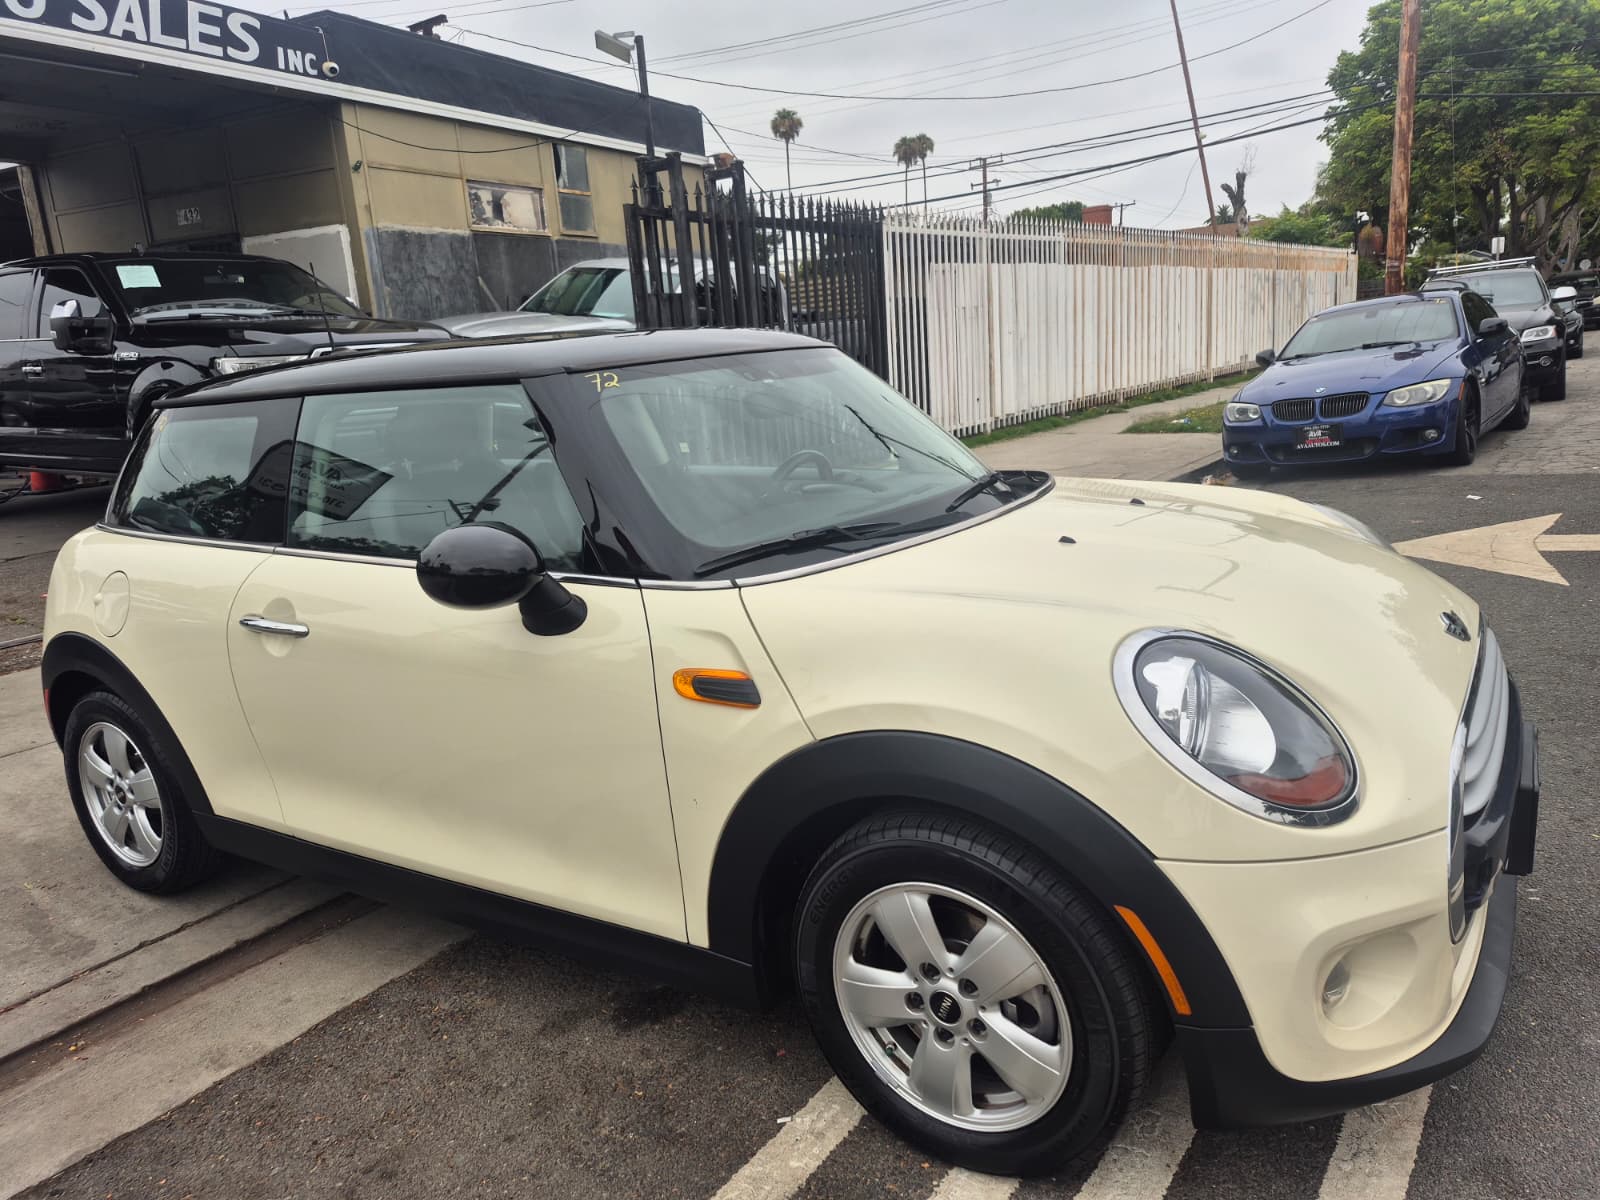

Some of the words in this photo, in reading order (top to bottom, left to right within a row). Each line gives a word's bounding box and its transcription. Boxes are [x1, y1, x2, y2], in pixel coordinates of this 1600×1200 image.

[71, 0, 261, 62] SALES
[277, 46, 318, 76] INC
[584, 372, 621, 392] 72
